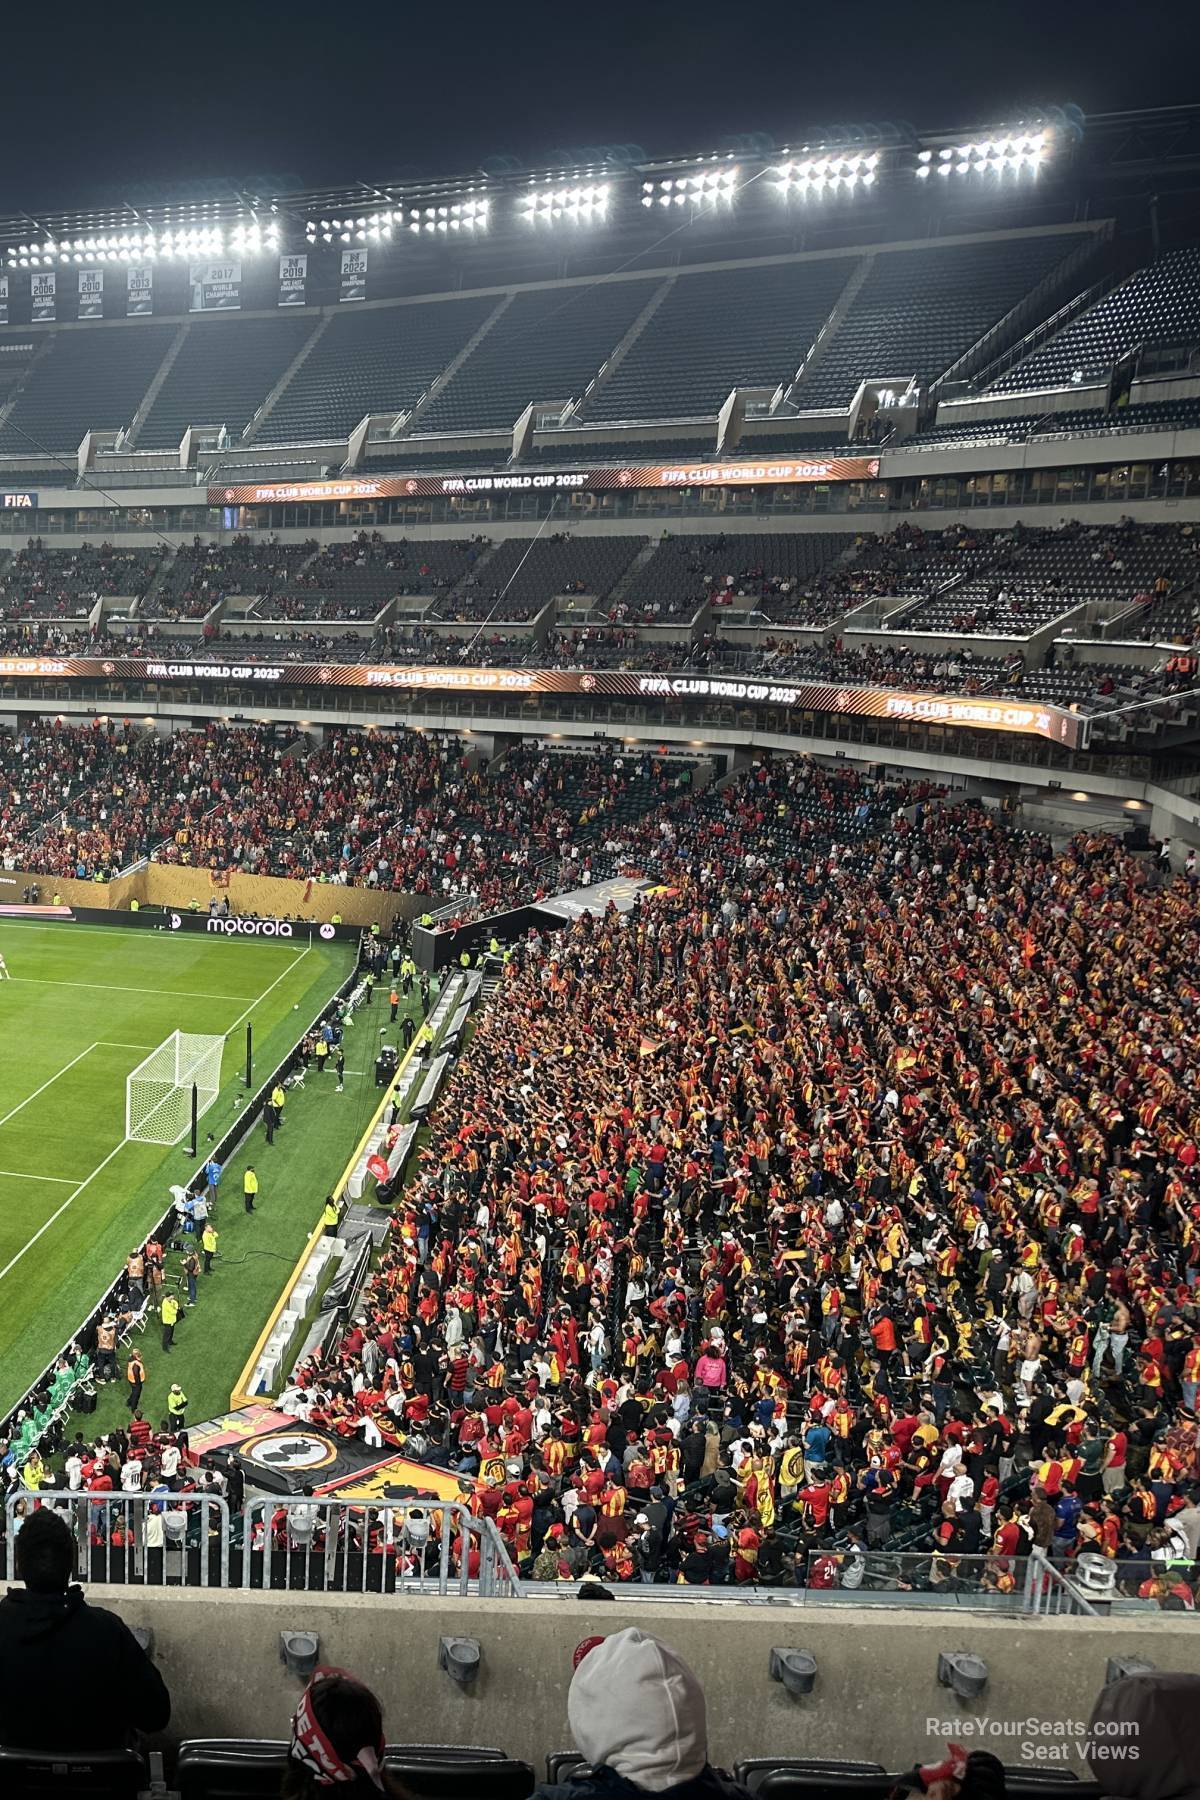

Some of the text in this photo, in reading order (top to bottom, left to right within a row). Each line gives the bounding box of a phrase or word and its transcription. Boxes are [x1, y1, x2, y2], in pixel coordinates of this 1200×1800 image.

[212, 269, 233, 279] 2017
[344, 263, 365, 273] 2022
[33, 285, 54, 294] 2006
[82, 282, 100, 291] 2010
[661, 471, 687, 481] FIFA
[691, 470, 719, 480] CLUB
[721, 468, 765, 479] WORLD
[767, 467, 793, 477] CUP
[442, 479, 464, 490] FIFA
[465, 478, 492, 489] CLUB
[493, 477, 531, 488] WORLD
[532, 476, 555, 487] CUP
[256, 489, 274, 498] FIFA
[276, 487, 298, 497] CLUB
[300, 486, 331, 496] WORLD
[333, 485, 352, 495] CUP
[4, 495, 32, 507] FIFA
[146, 664, 169, 675] FIFA
[169, 665, 193, 676] CLUB
[194, 666, 230, 677] WORLD
[232, 667, 253, 678] CUP
[367, 672, 392, 683] FIFA
[392, 673, 424, 684] CLUB
[426, 673, 468, 685] WORLD
[471, 675, 497, 686] CUP
[640, 679, 671, 692] FIFA
[672, 680, 709, 693] CLUB
[710, 682, 746, 697] WORLD
[746, 685, 769, 699] CUP
[887, 700, 912, 713] FIFA
[913, 702, 949, 717] CLUB
[952, 705, 1000, 722] WORLD
[1003, 709, 1033, 726] CUP
[207, 917, 293, 936] motorola
[130, 1473, 140, 1486] 10
